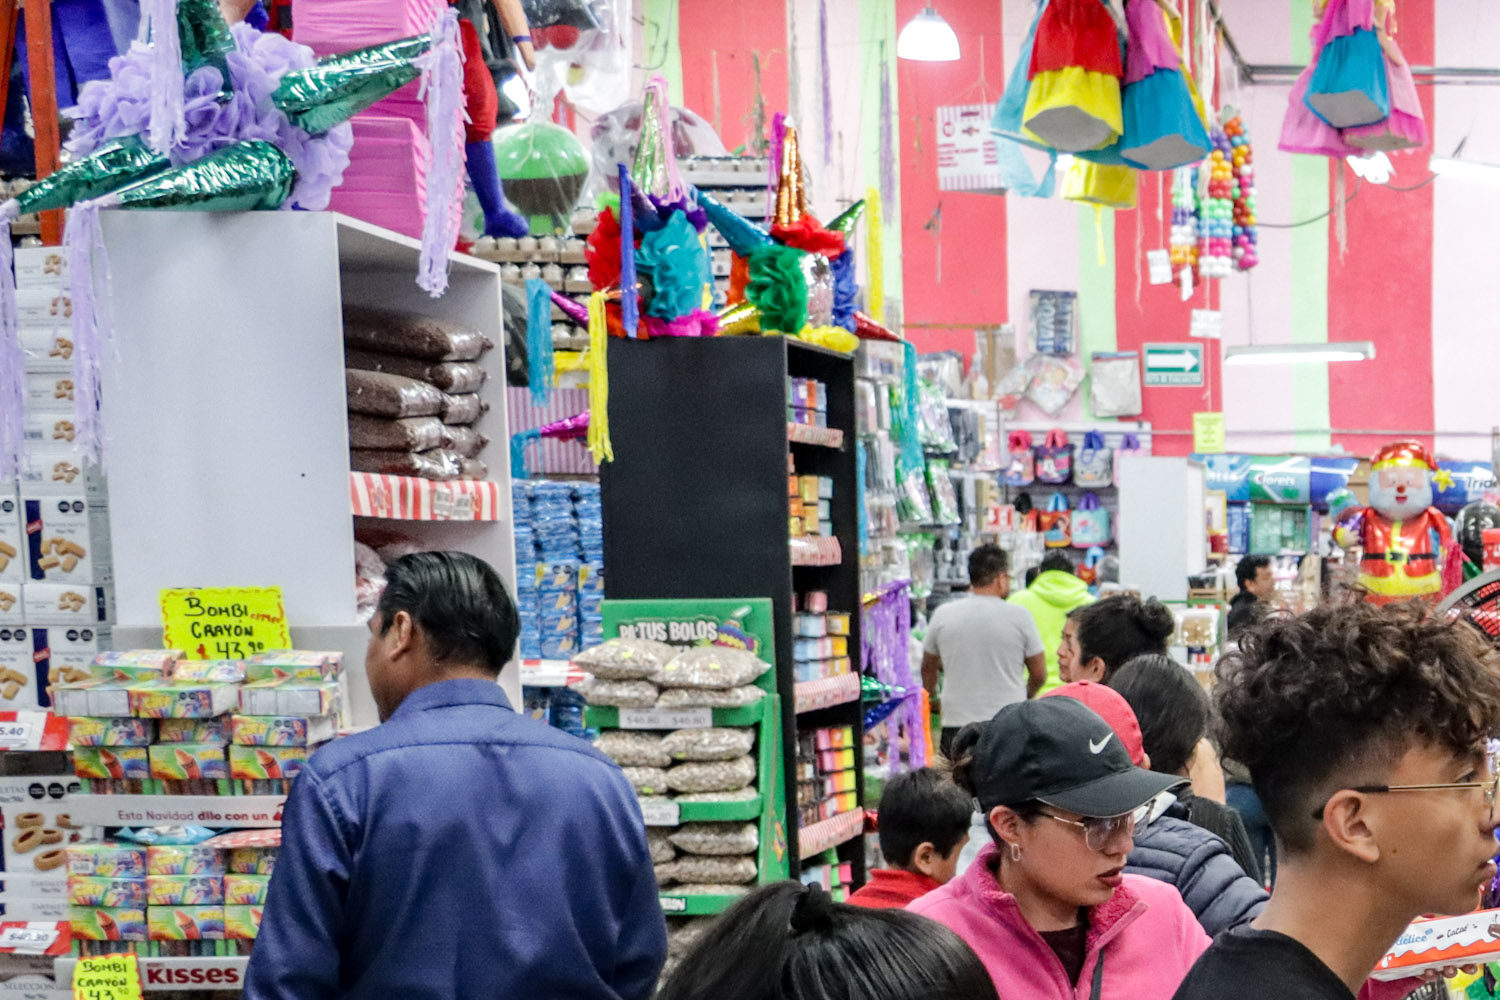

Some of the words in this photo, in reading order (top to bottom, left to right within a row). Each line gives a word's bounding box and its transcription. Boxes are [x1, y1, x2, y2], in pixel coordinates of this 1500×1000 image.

[1253, 473, 1296, 486] Clorets
[184, 597, 249, 618] BOMBI
[668, 620, 719, 641] BOLOS
[146, 810, 195, 821] Navidad
[198, 810, 222, 821] dilo
[225, 812, 249, 821] con
[252, 812, 269, 821] un
[82, 962, 128, 973] BOMBI
